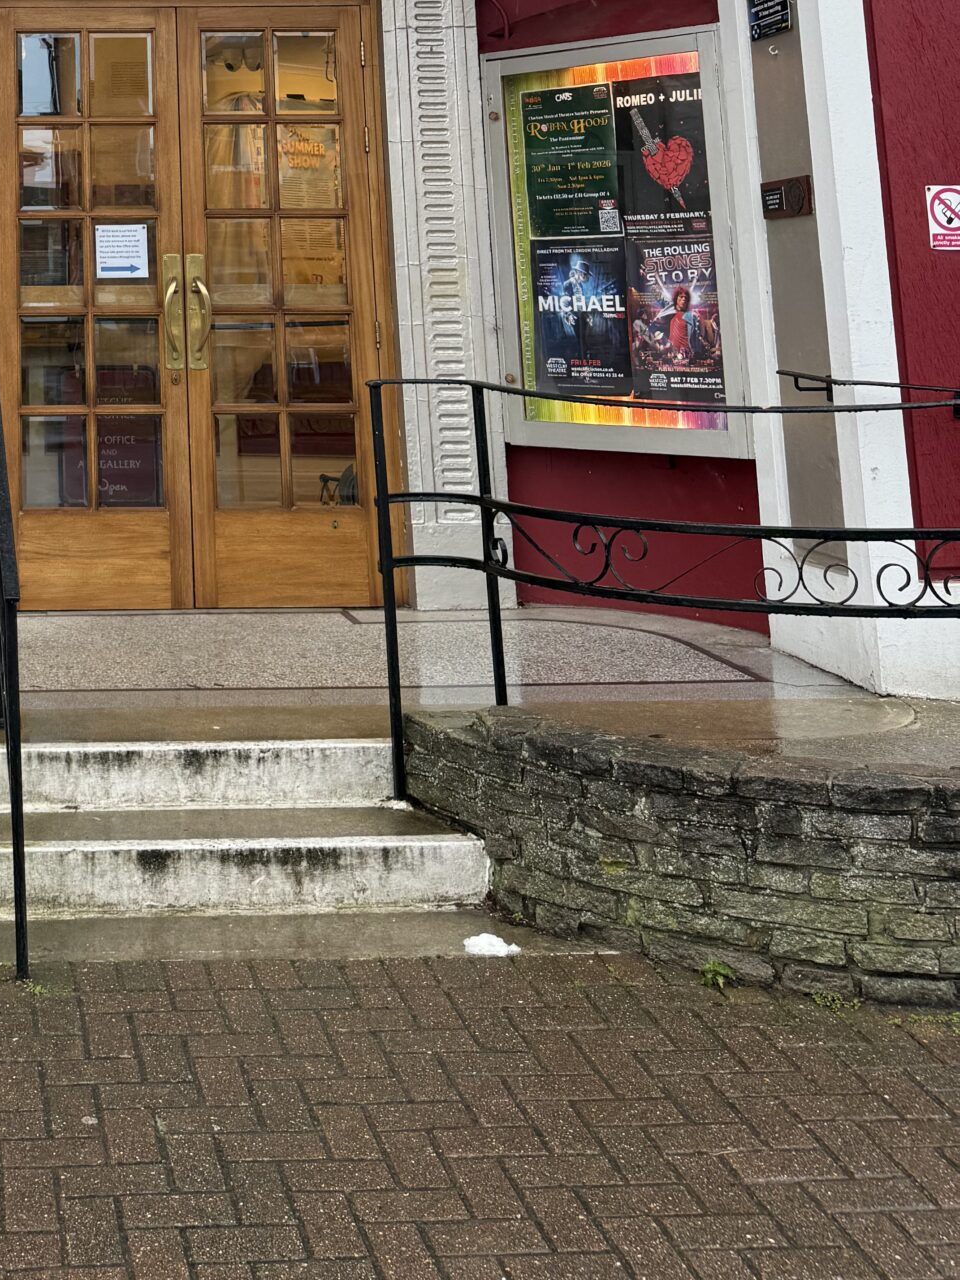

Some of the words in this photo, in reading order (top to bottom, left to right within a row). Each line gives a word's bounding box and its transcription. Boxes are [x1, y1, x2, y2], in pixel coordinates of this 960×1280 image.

[616, 93, 655, 108] ROMEO
[659, 93, 664, 102] +
[570, 117, 608, 133] HOOD
[282, 141, 326, 156] SUMMER
[288, 155, 320, 169] SHOW
[547, 164, 560, 172] Jan
[577, 161, 590, 169] Feb
[592, 160, 611, 168] 2026
[644, 248, 662, 258] THE
[664, 243, 710, 256] ROLLING
[644, 252, 712, 273] STONES
[646, 268, 711, 285] STORY
[538, 294, 625, 312] MICHAEL
[105, 435, 136, 444] OFFICE
[100, 460, 142, 469] GALLERY
